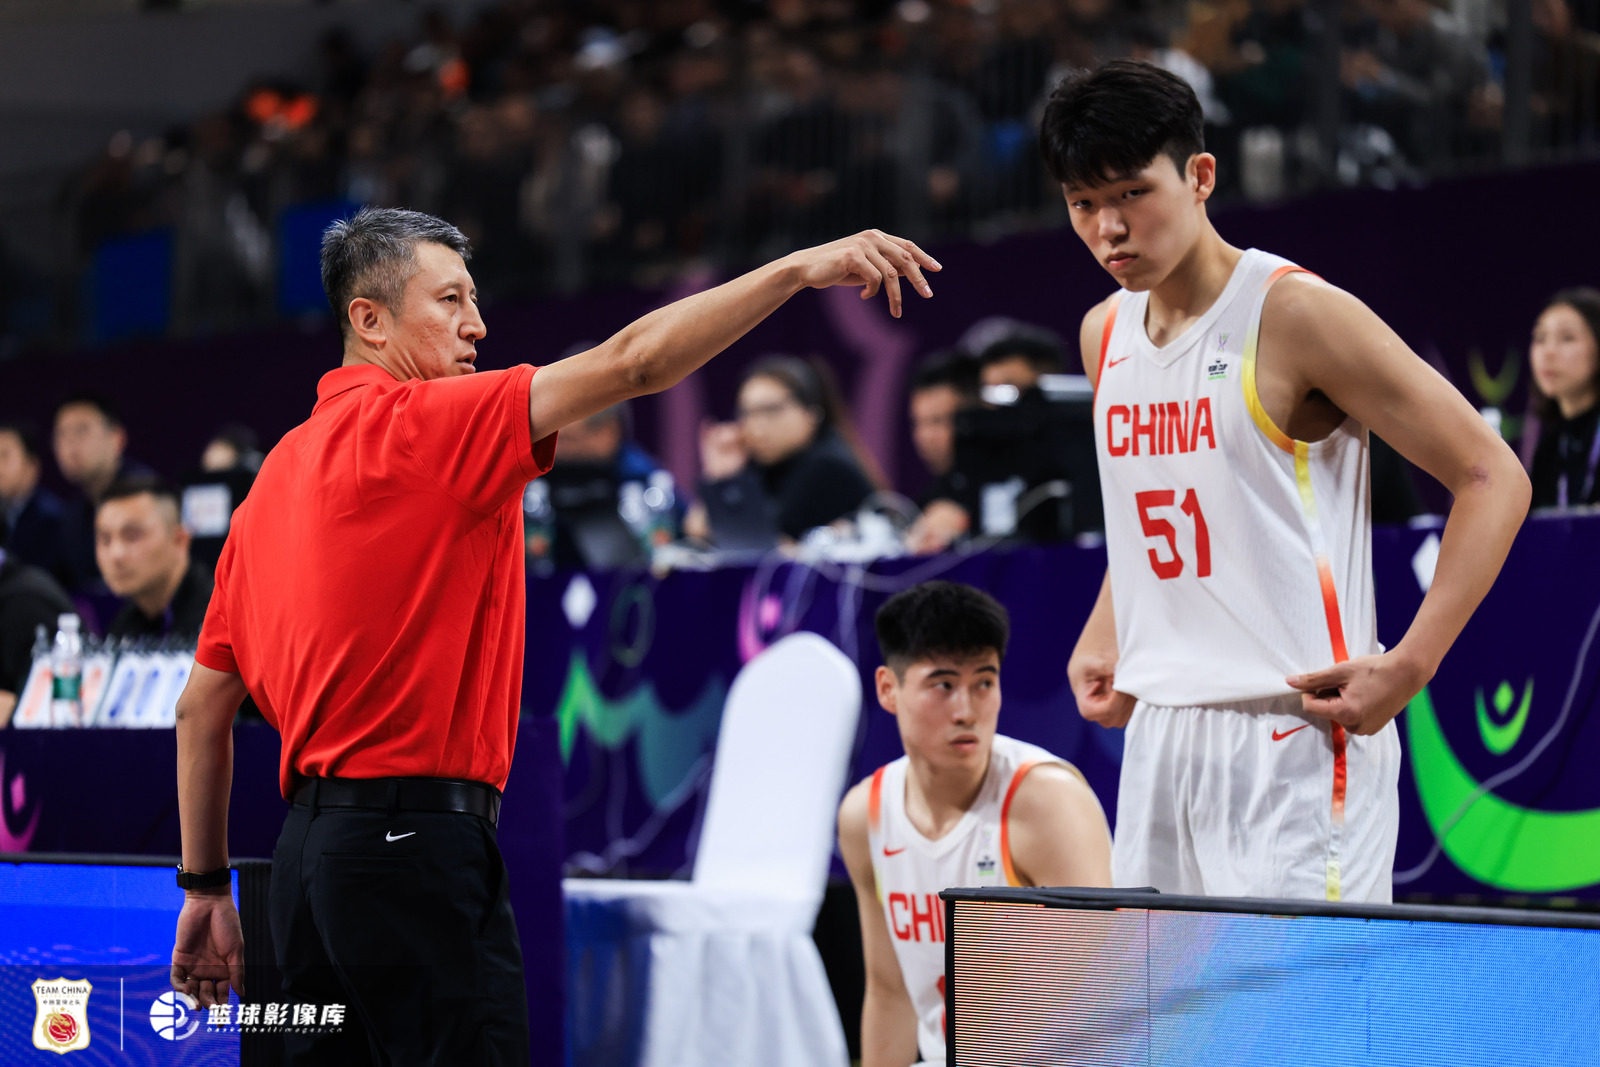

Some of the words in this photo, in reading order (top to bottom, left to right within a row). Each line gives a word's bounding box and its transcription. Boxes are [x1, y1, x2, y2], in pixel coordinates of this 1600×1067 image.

[1107, 397, 1217, 457] CHINA
[1135, 488, 1212, 581] 51
[889, 892, 946, 943] CHI
